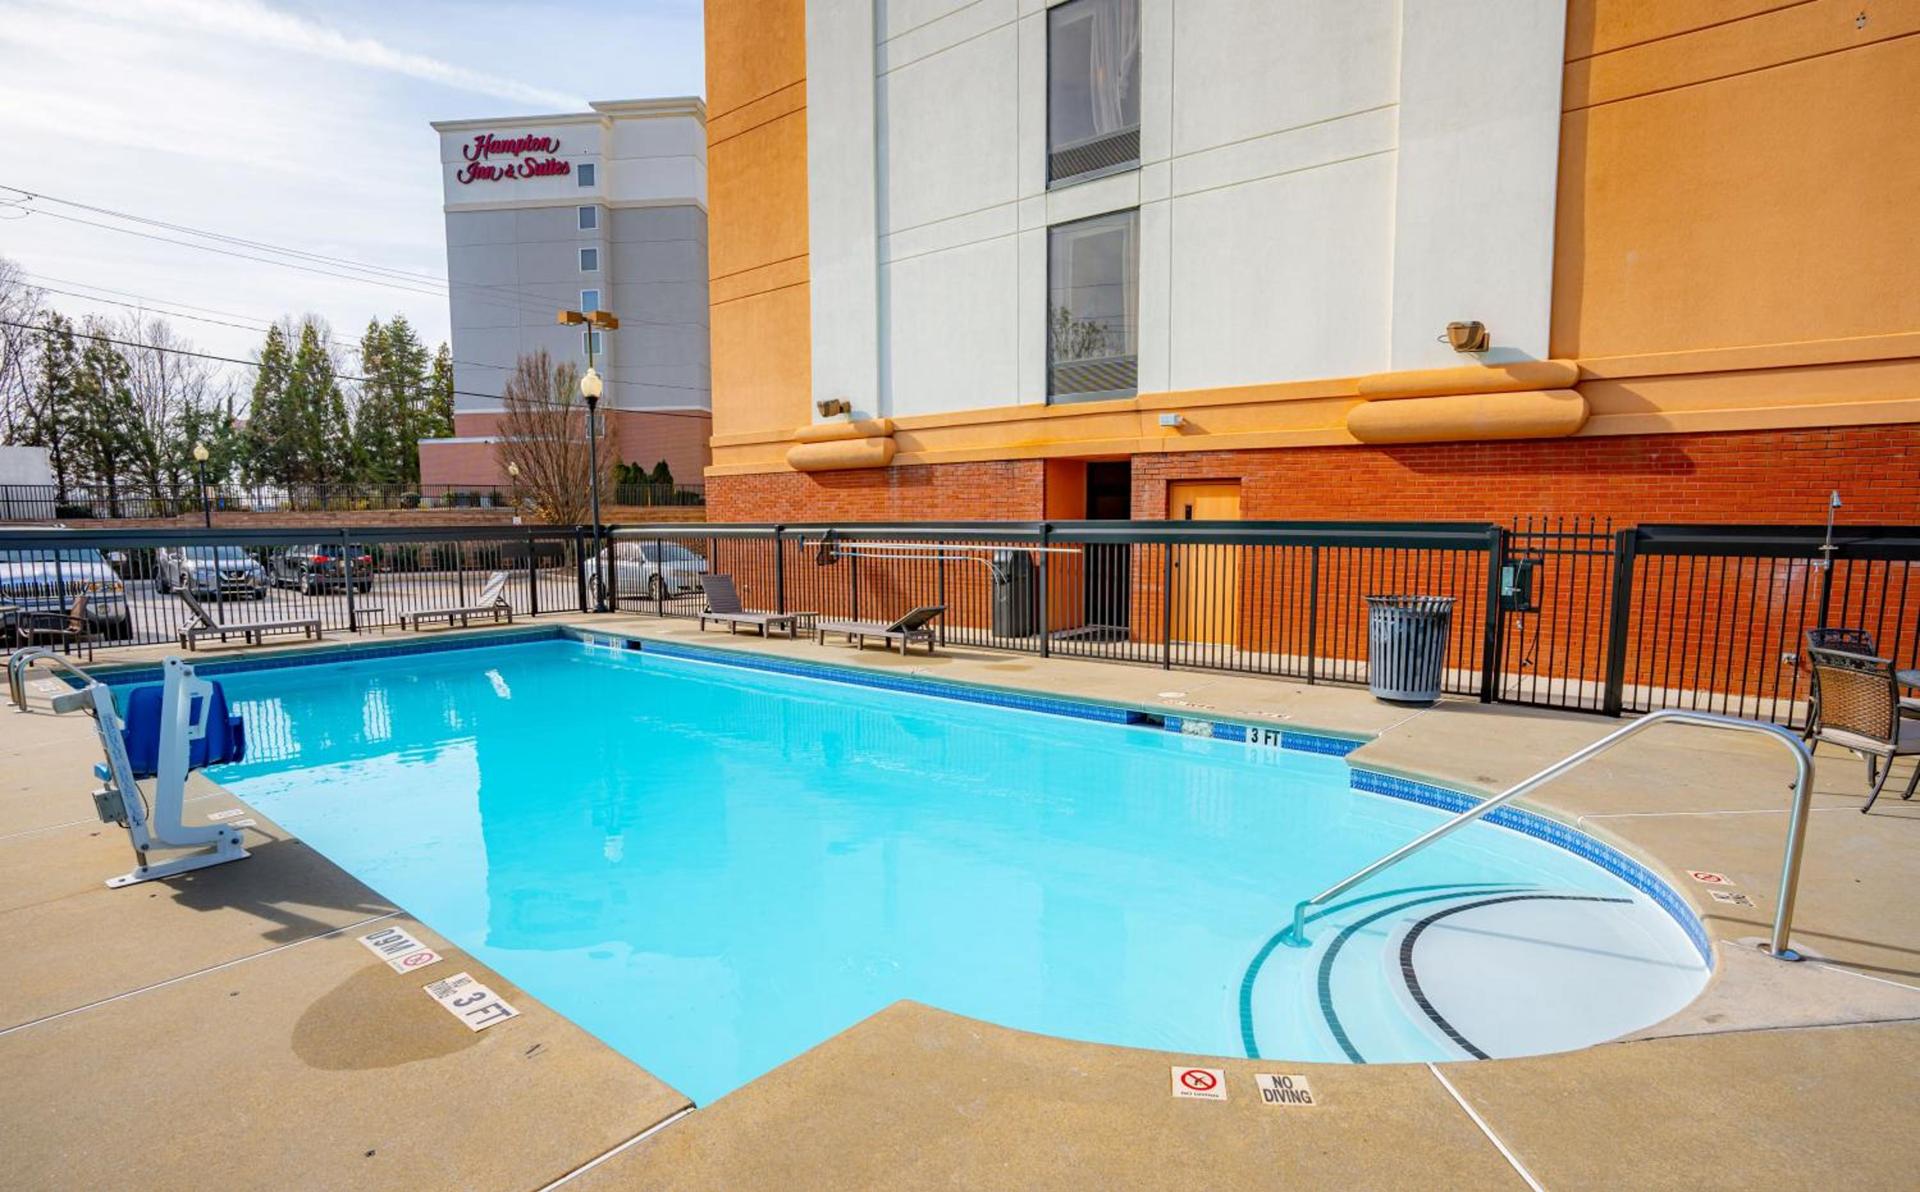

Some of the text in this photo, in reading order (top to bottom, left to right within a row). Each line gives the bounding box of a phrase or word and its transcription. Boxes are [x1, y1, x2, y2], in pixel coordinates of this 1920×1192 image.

[463, 133, 560, 161] Hampton
[457, 157, 570, 184] Inn & Suites
[1251, 728, 1280, 747] 3 FT
[453, 991, 513, 1025] 3 FT
[1271, 1076, 1293, 1090] NO
[1262, 1088, 1313, 1104] DIVING
